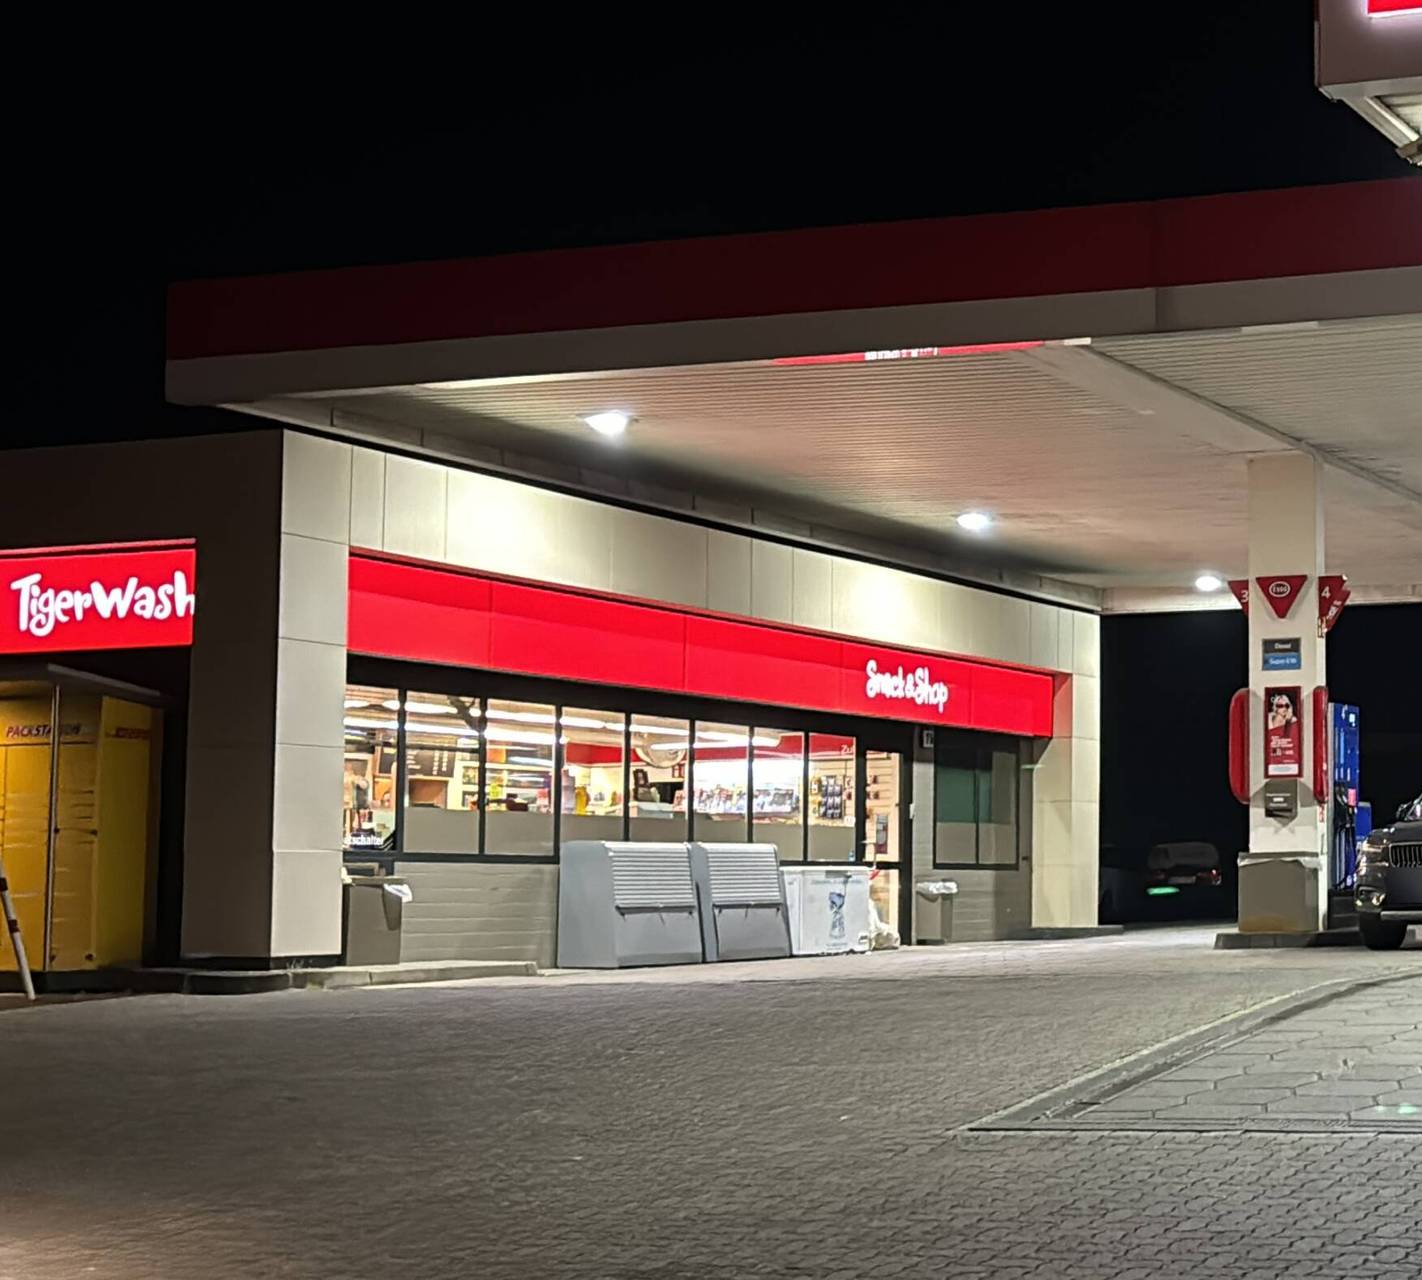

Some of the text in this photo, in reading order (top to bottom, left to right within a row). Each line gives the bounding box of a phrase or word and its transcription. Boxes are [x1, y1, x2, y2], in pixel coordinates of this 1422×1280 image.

[1240, 590, 1249, 603] 3
[1321, 586, 1331, 599] 4
[10, 570, 196, 637] TigerWash
